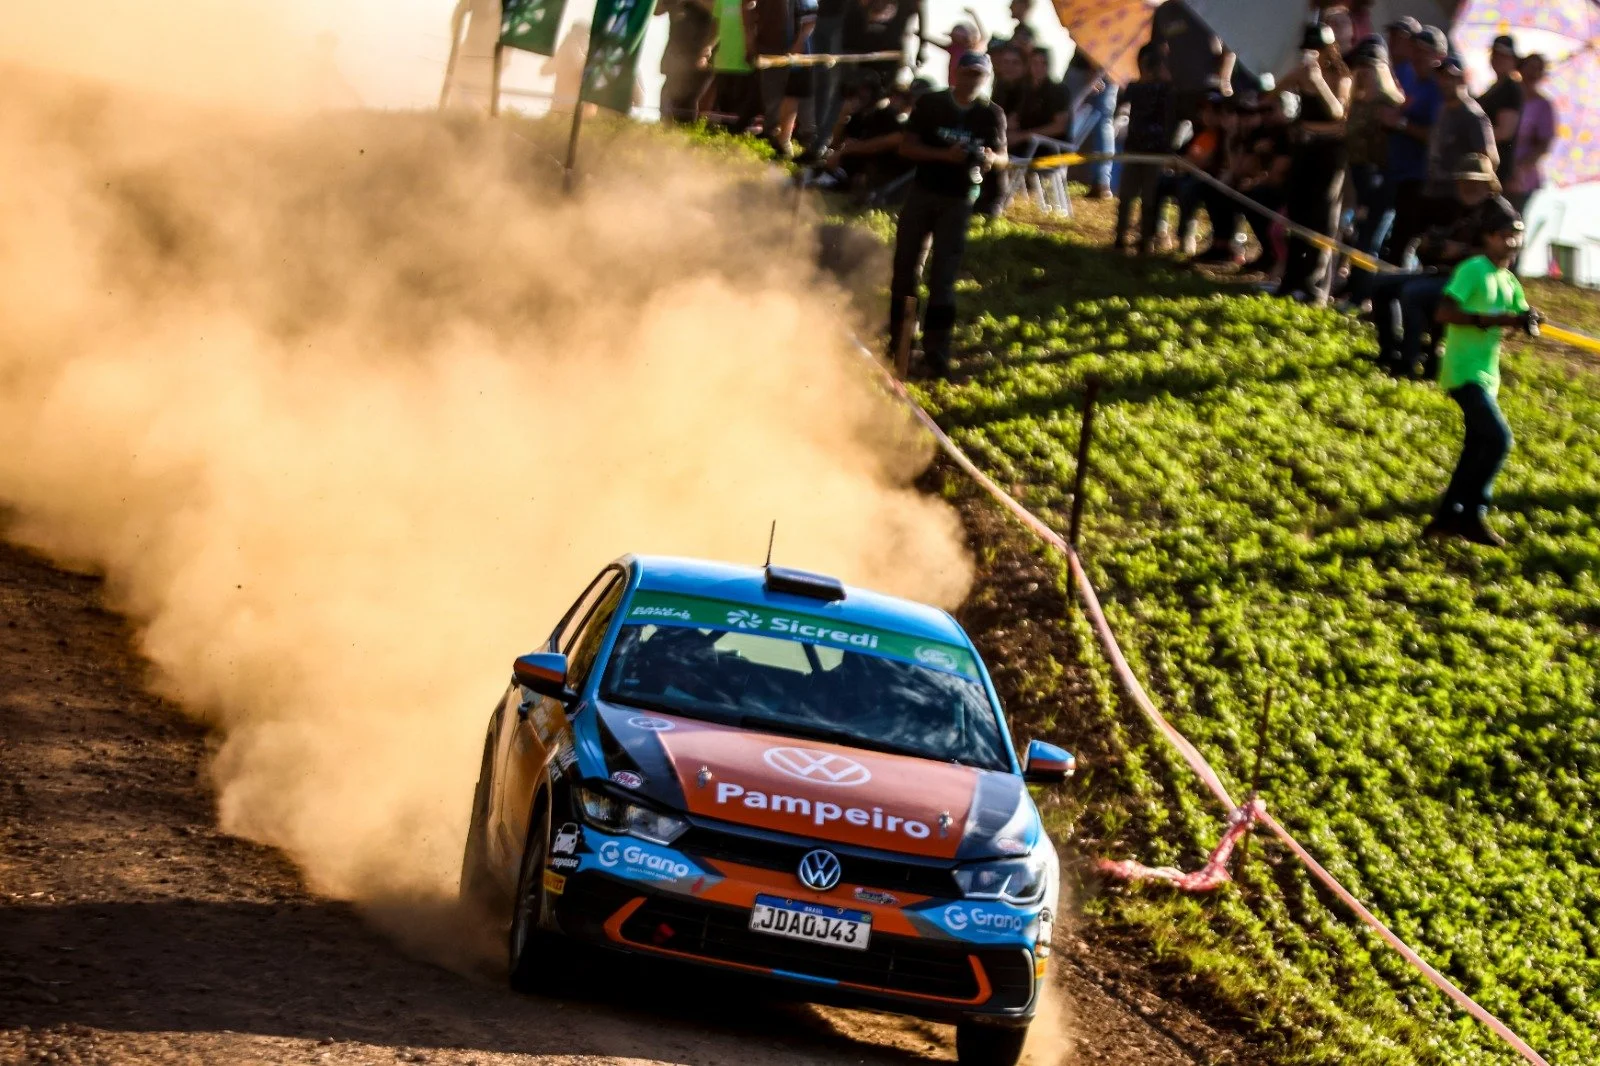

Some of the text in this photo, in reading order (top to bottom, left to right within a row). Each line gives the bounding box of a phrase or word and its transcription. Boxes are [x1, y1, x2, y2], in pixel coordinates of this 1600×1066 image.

[769, 617, 879, 648] Sicredi
[717, 782, 931, 839] Pampeiro
[623, 846, 689, 877] Grano
[804, 905, 823, 914] BRASIL
[971, 907, 1022, 931] Grano
